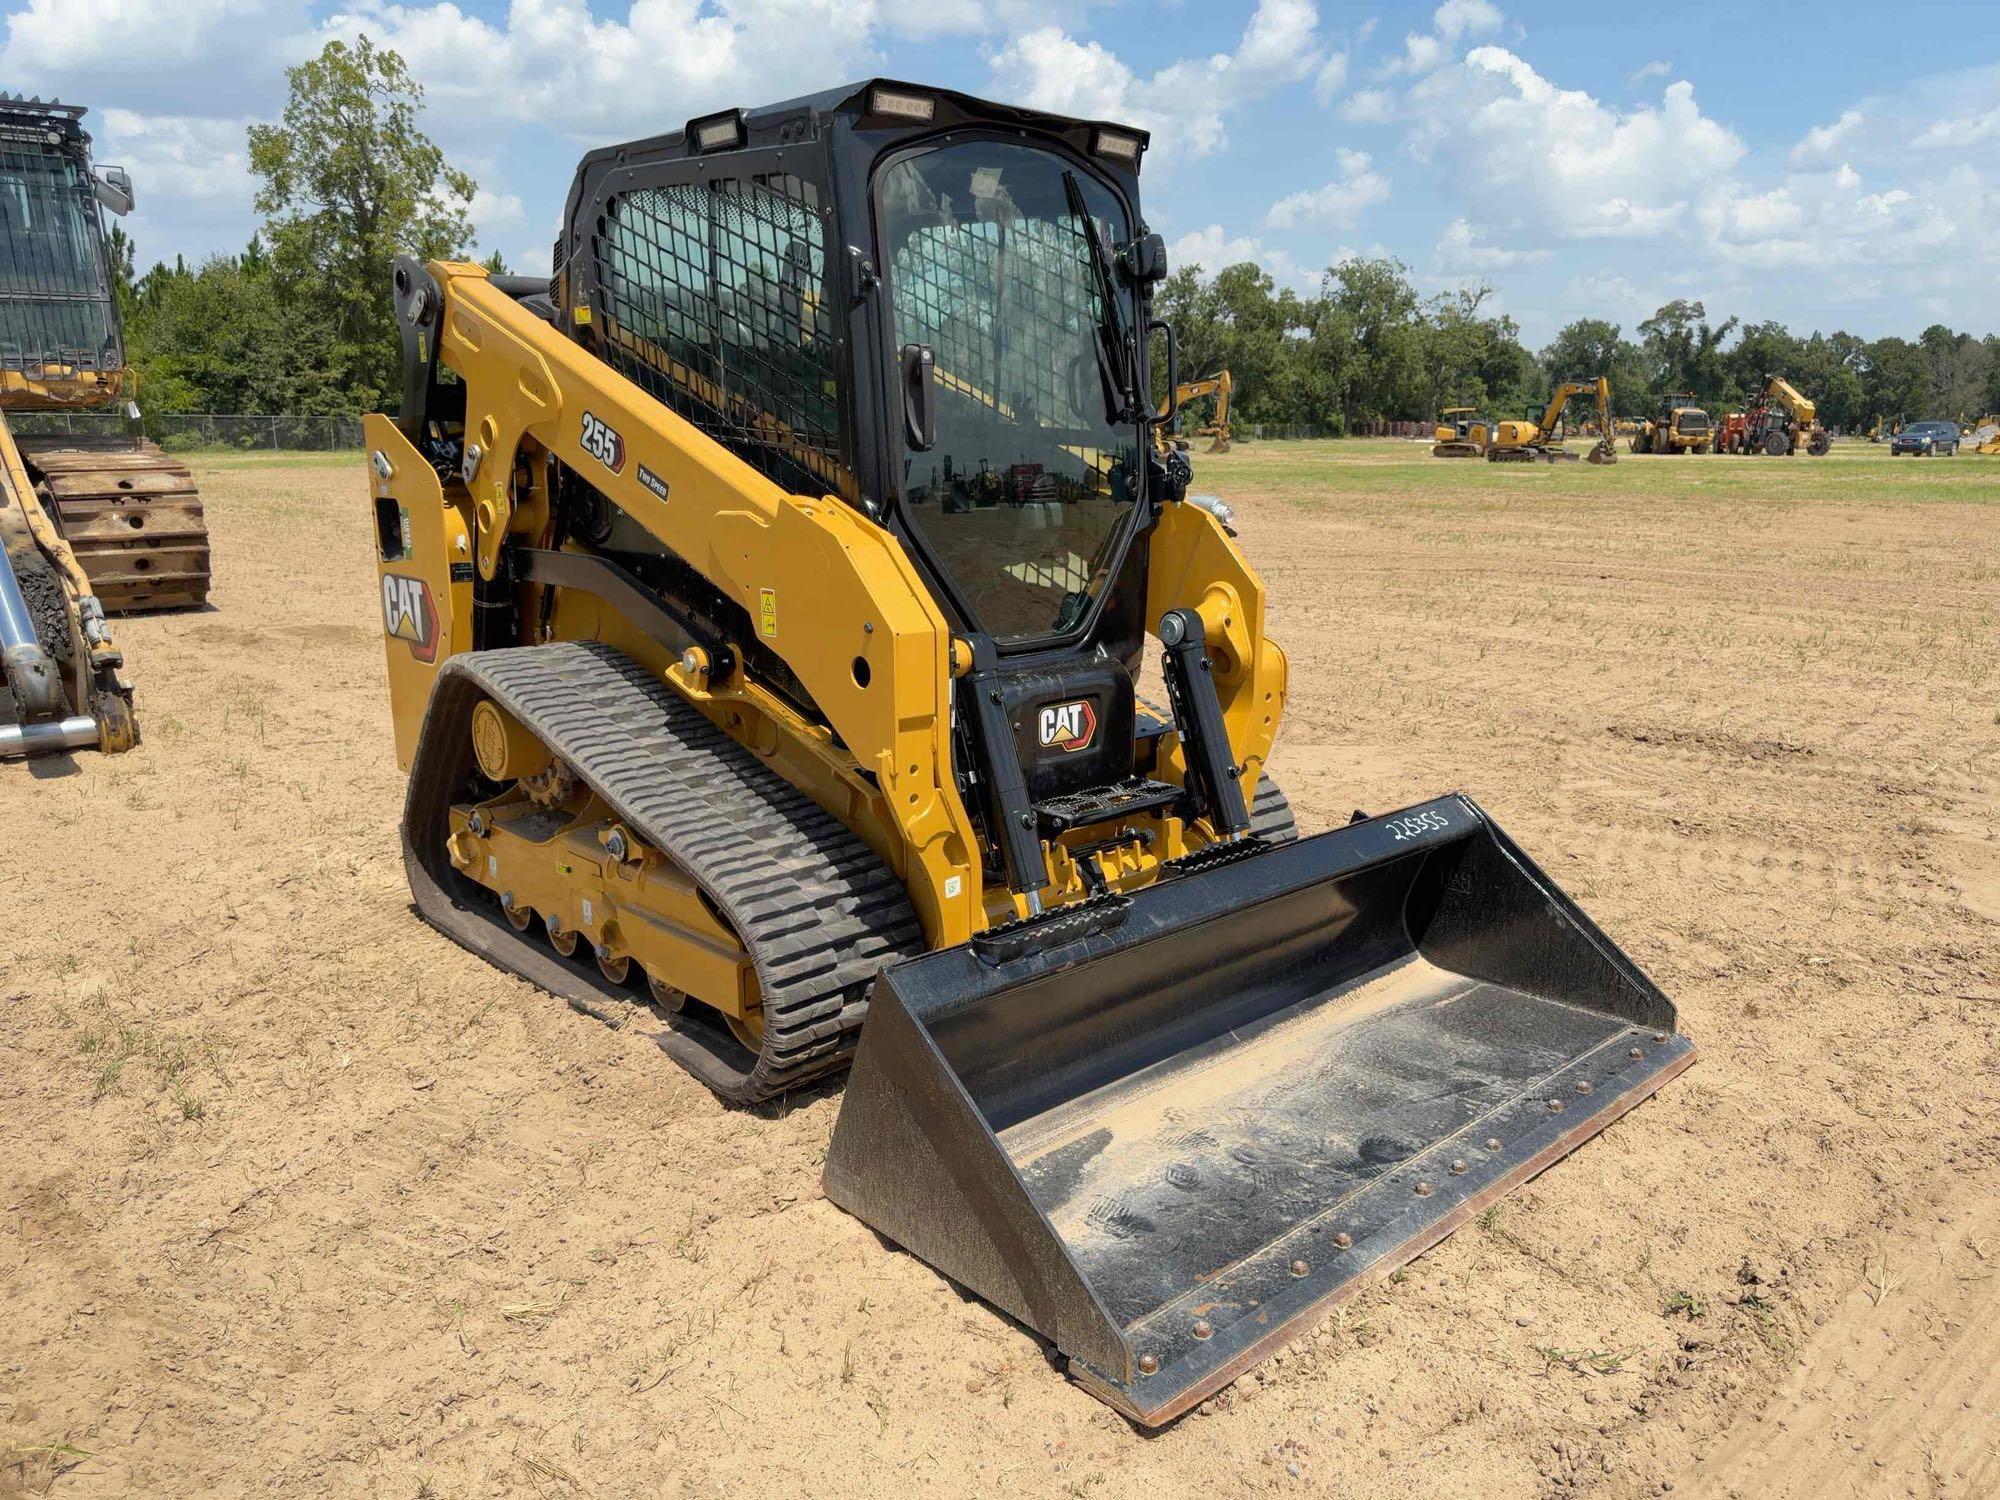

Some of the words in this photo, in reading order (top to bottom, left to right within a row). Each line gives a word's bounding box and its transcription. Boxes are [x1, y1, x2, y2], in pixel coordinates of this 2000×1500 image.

[581, 412, 617, 467] 255
[383, 574, 424, 643] CAT
[1040, 704, 1082, 744] CAT
[1385, 811, 1449, 840] 225355
